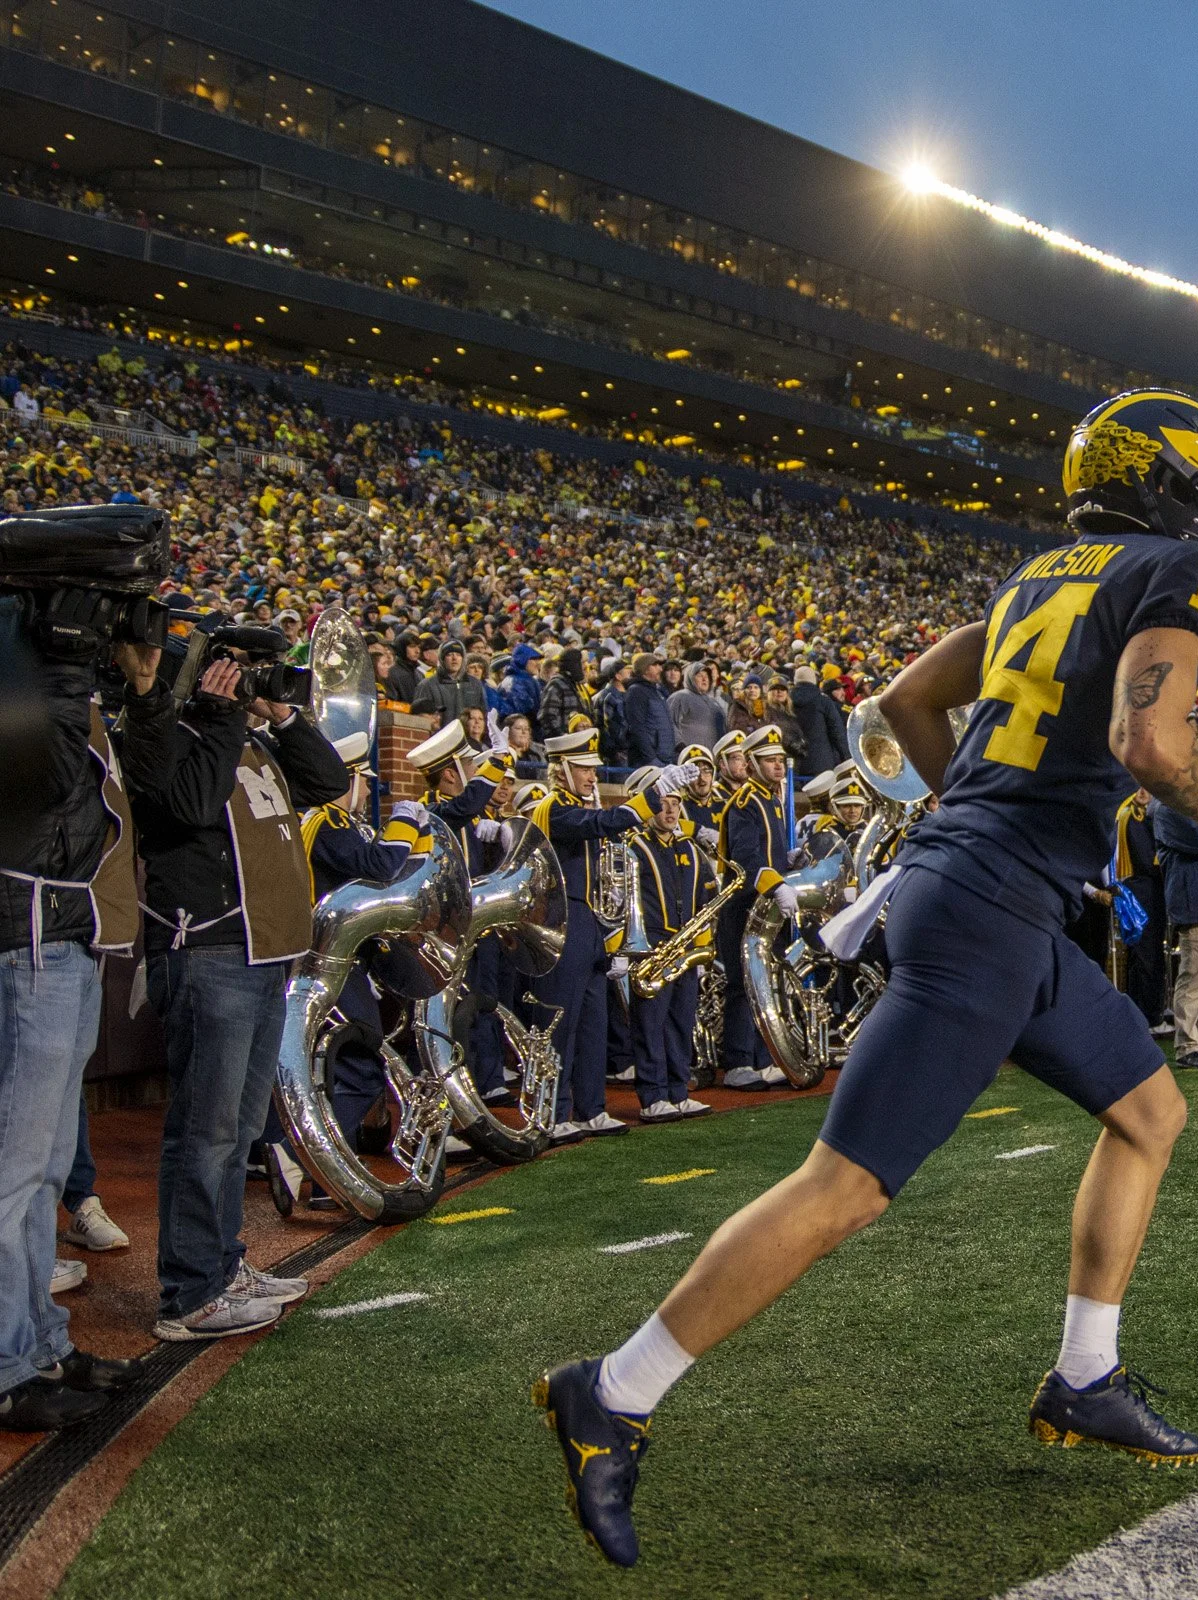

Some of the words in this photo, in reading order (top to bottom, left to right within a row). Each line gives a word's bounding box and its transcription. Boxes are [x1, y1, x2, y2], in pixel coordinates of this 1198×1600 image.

[1016, 544, 1125, 582] WILSON
[979, 582, 1101, 772] 14
[767, 732, 780, 744] M
[588, 738, 598, 751] M
[689, 748, 703, 758] M
[503, 755, 513, 767] M
[531, 789, 544, 801] M
[848, 784, 860, 795] M
